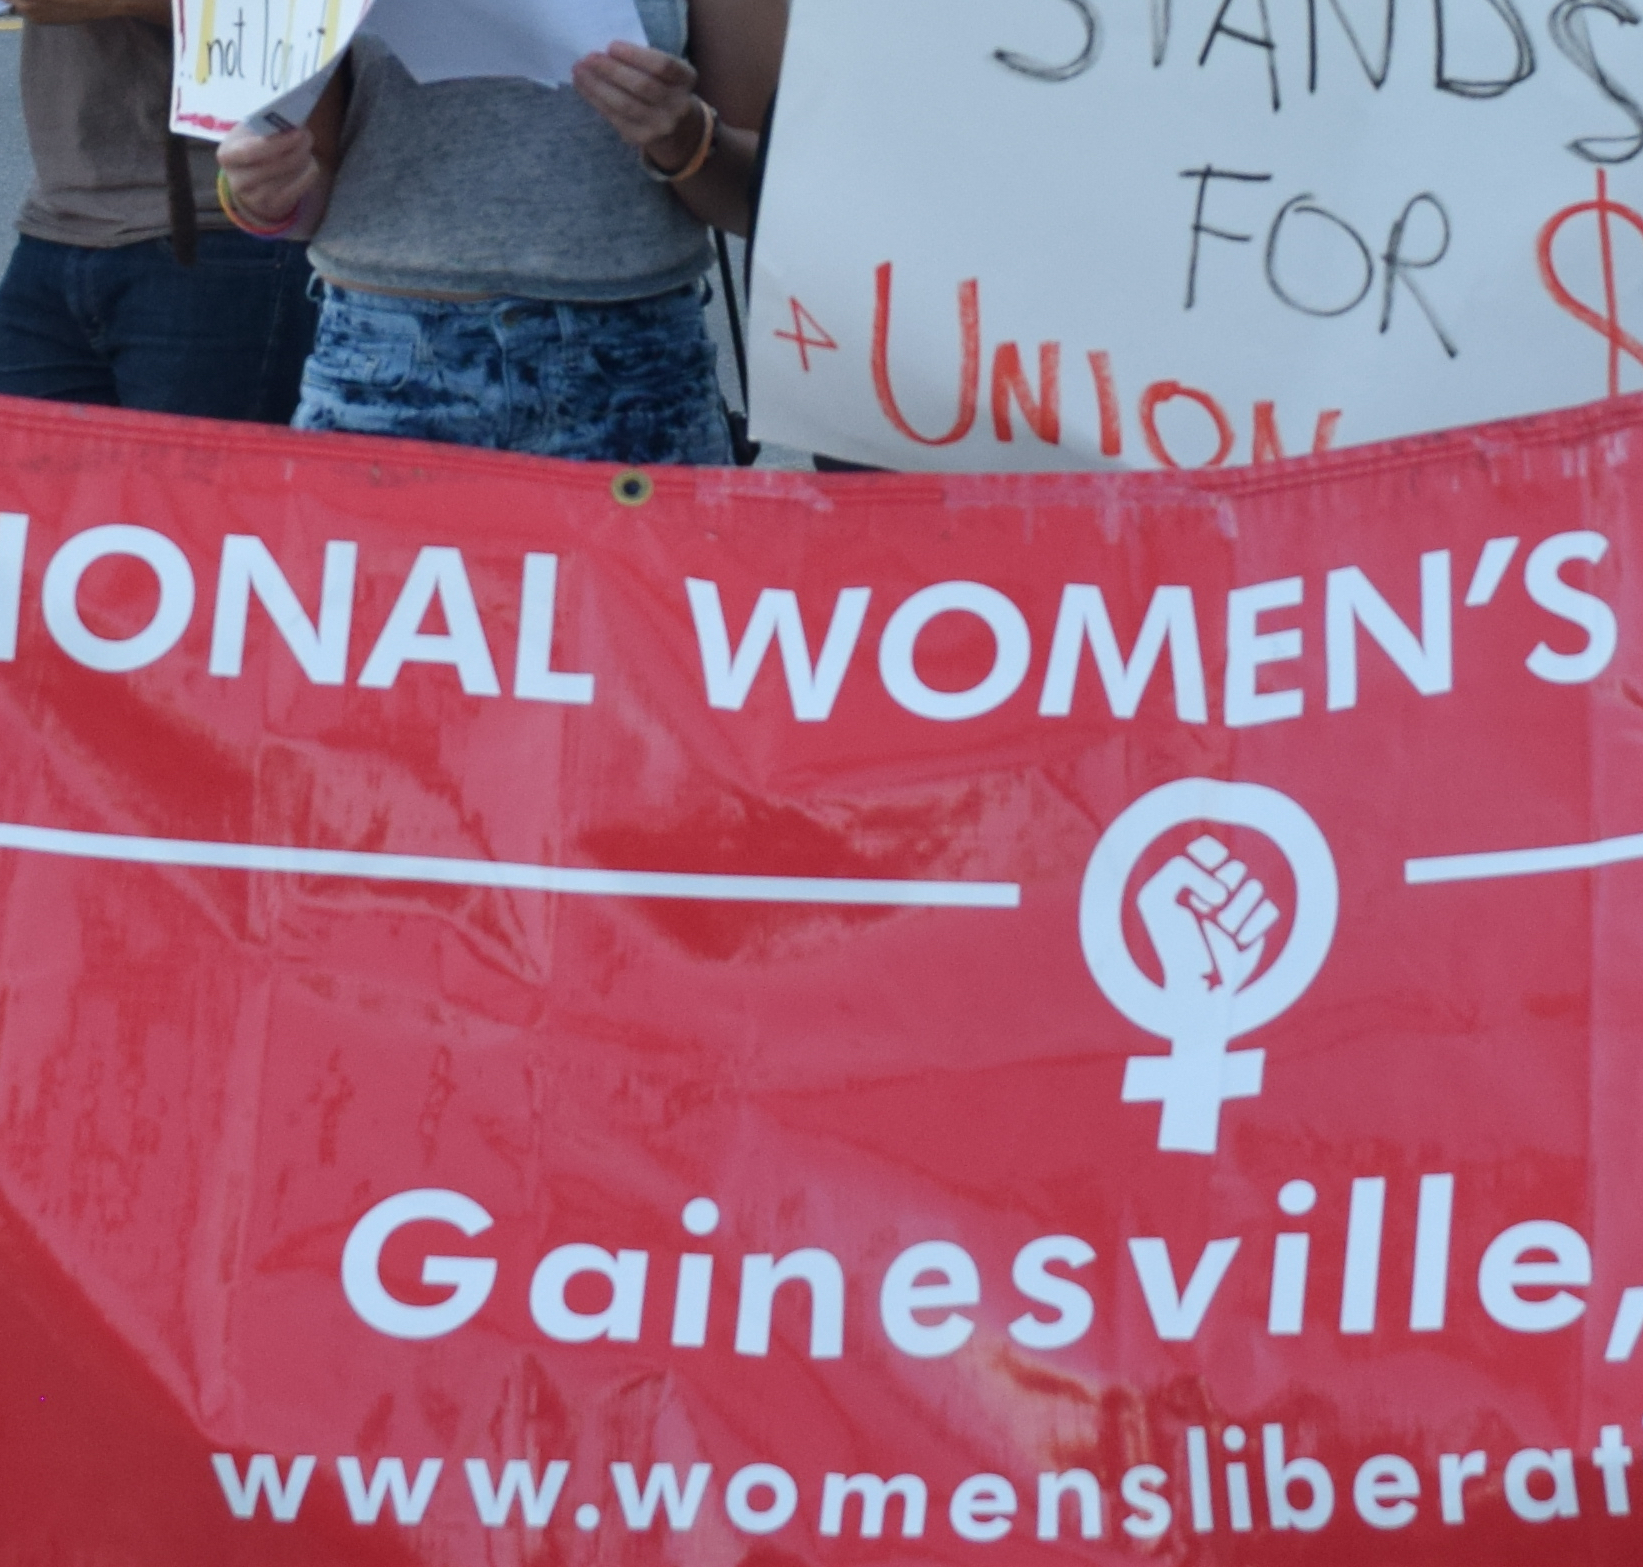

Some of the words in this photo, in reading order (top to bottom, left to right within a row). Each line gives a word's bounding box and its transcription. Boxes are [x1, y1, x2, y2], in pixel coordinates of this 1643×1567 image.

[1178, 164, 1460, 360] FOR
[872, 261, 1343, 468] UNION
[685, 530, 1618, 729] WOMEN'S
